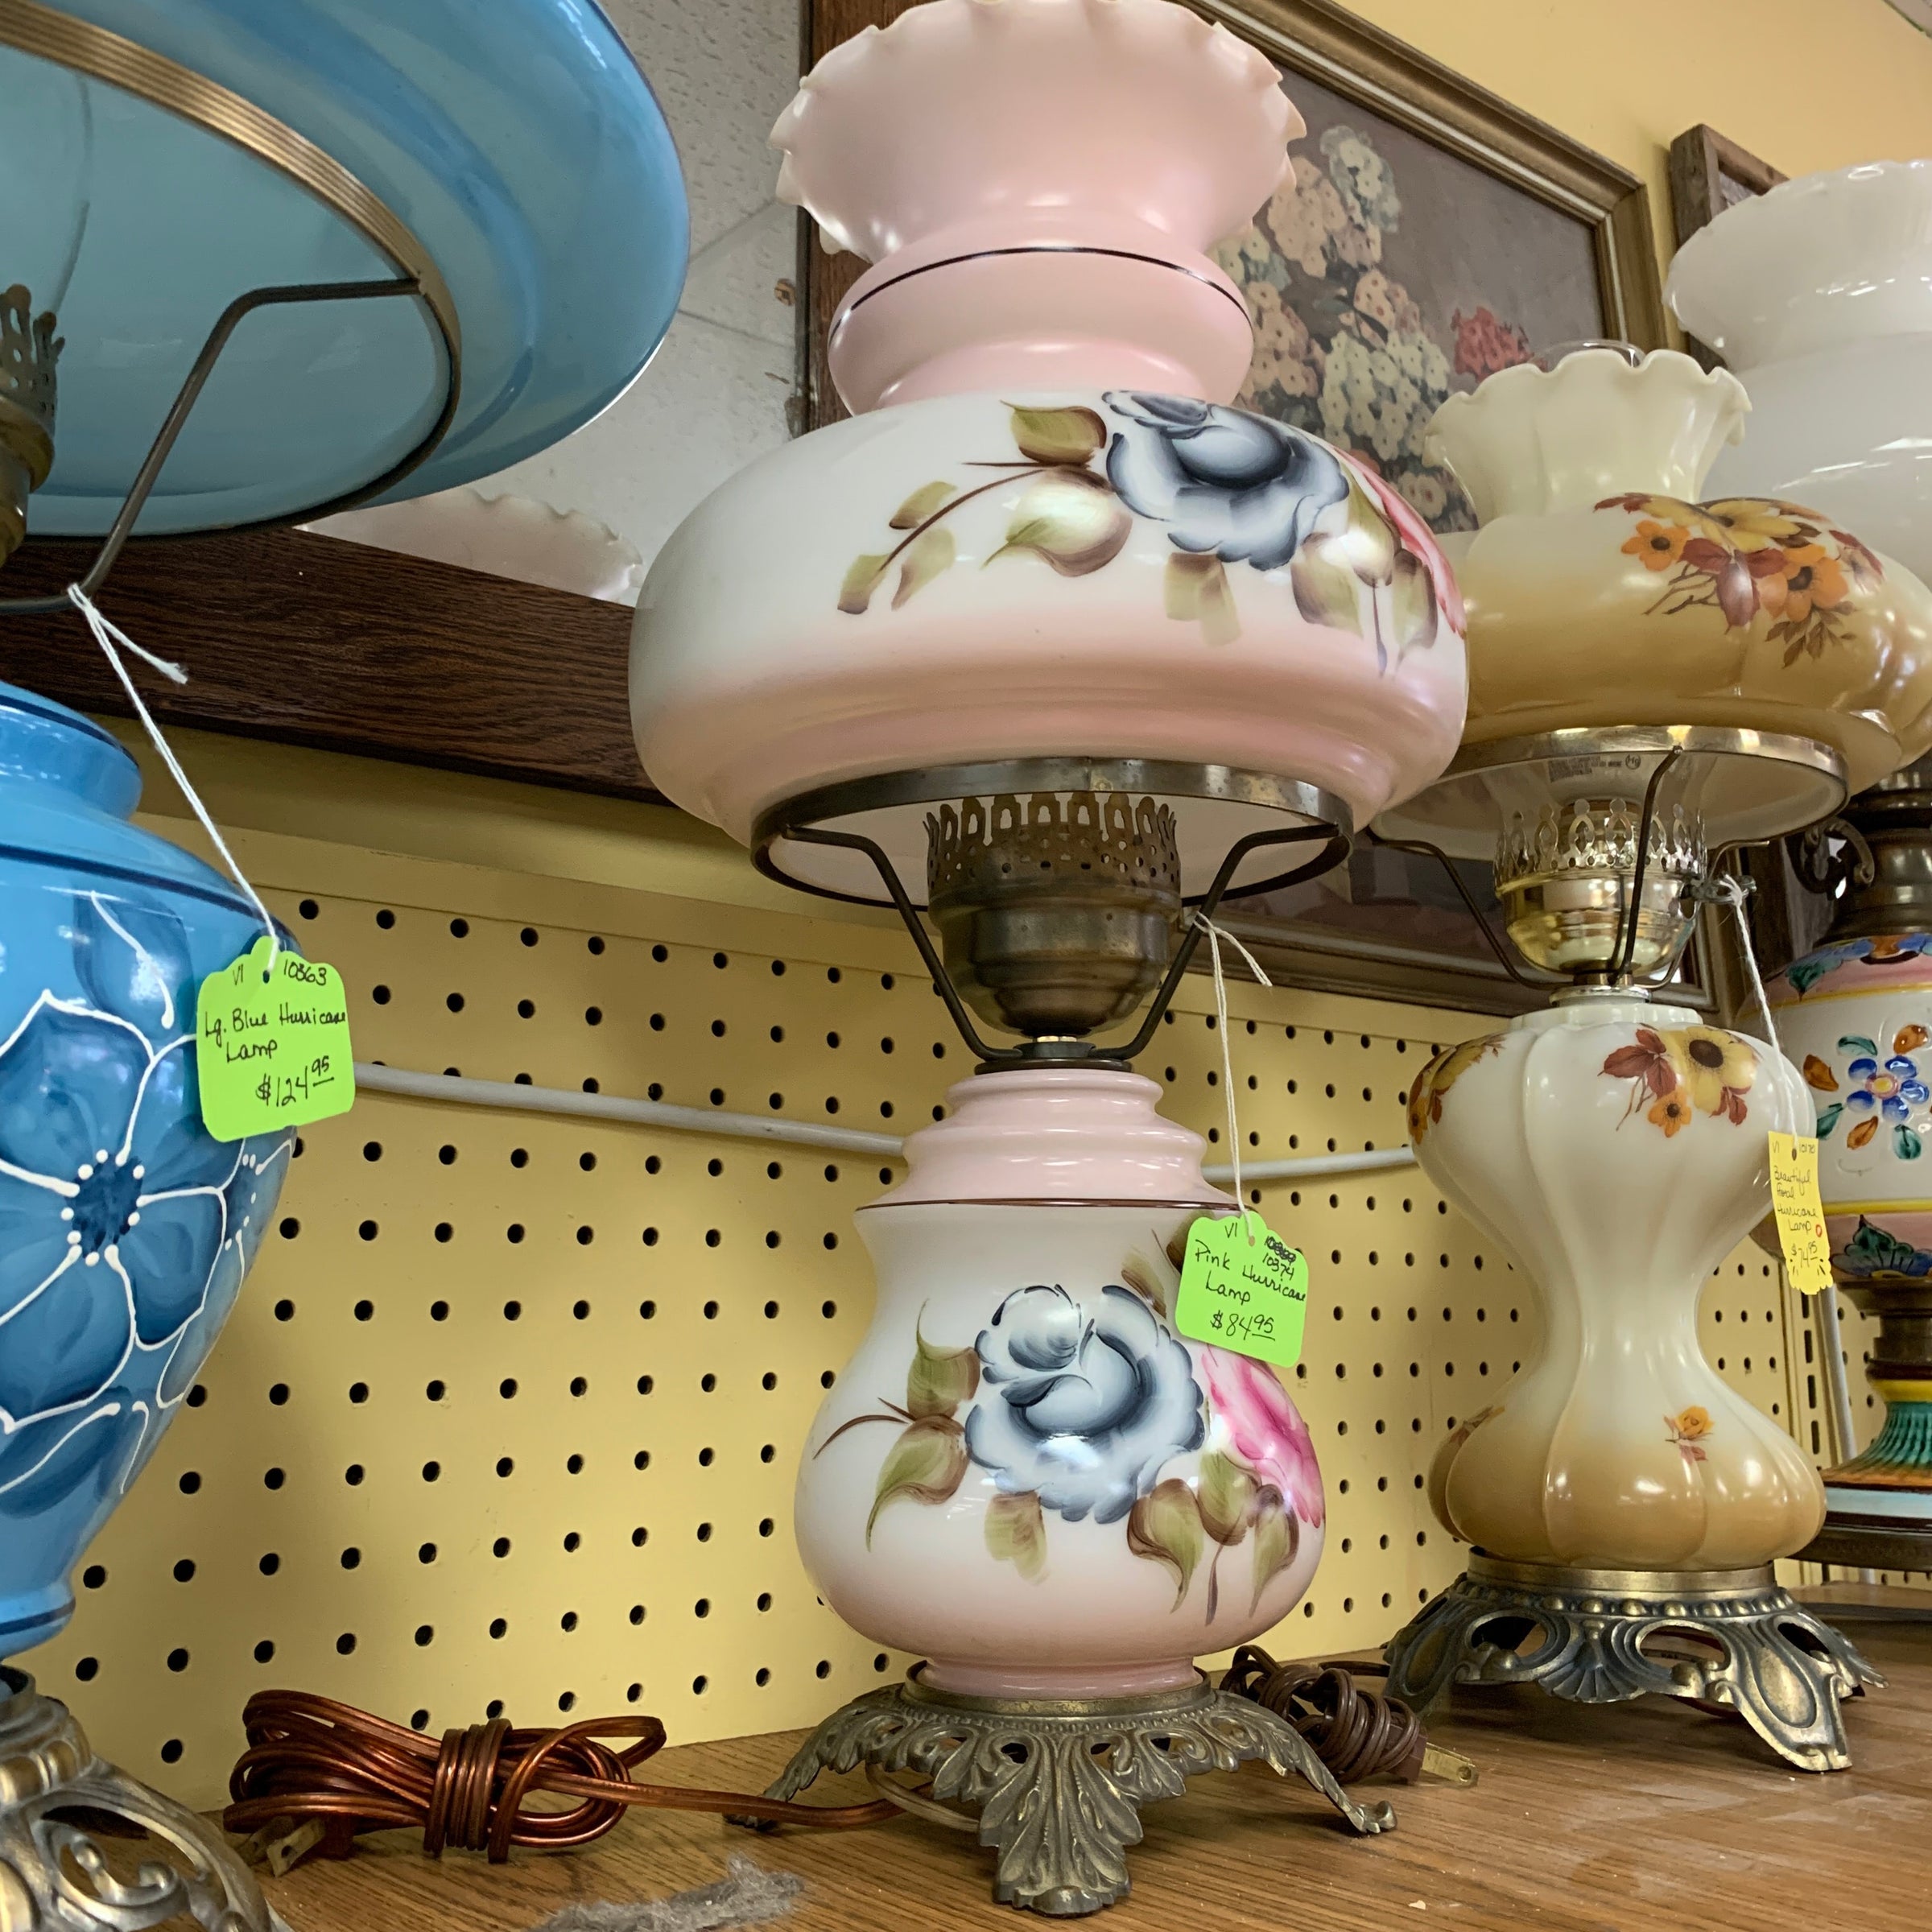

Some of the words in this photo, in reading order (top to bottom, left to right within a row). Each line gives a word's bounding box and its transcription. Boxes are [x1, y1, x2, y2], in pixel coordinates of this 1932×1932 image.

[232, 1007, 269, 1033] Blue
[226, 1039, 278, 1063] Lamp
[1788, 1219, 1811, 1234] Lamp
[1195, 1239, 1230, 1270] Pink
[1205, 1270, 1251, 1306] Lamp
